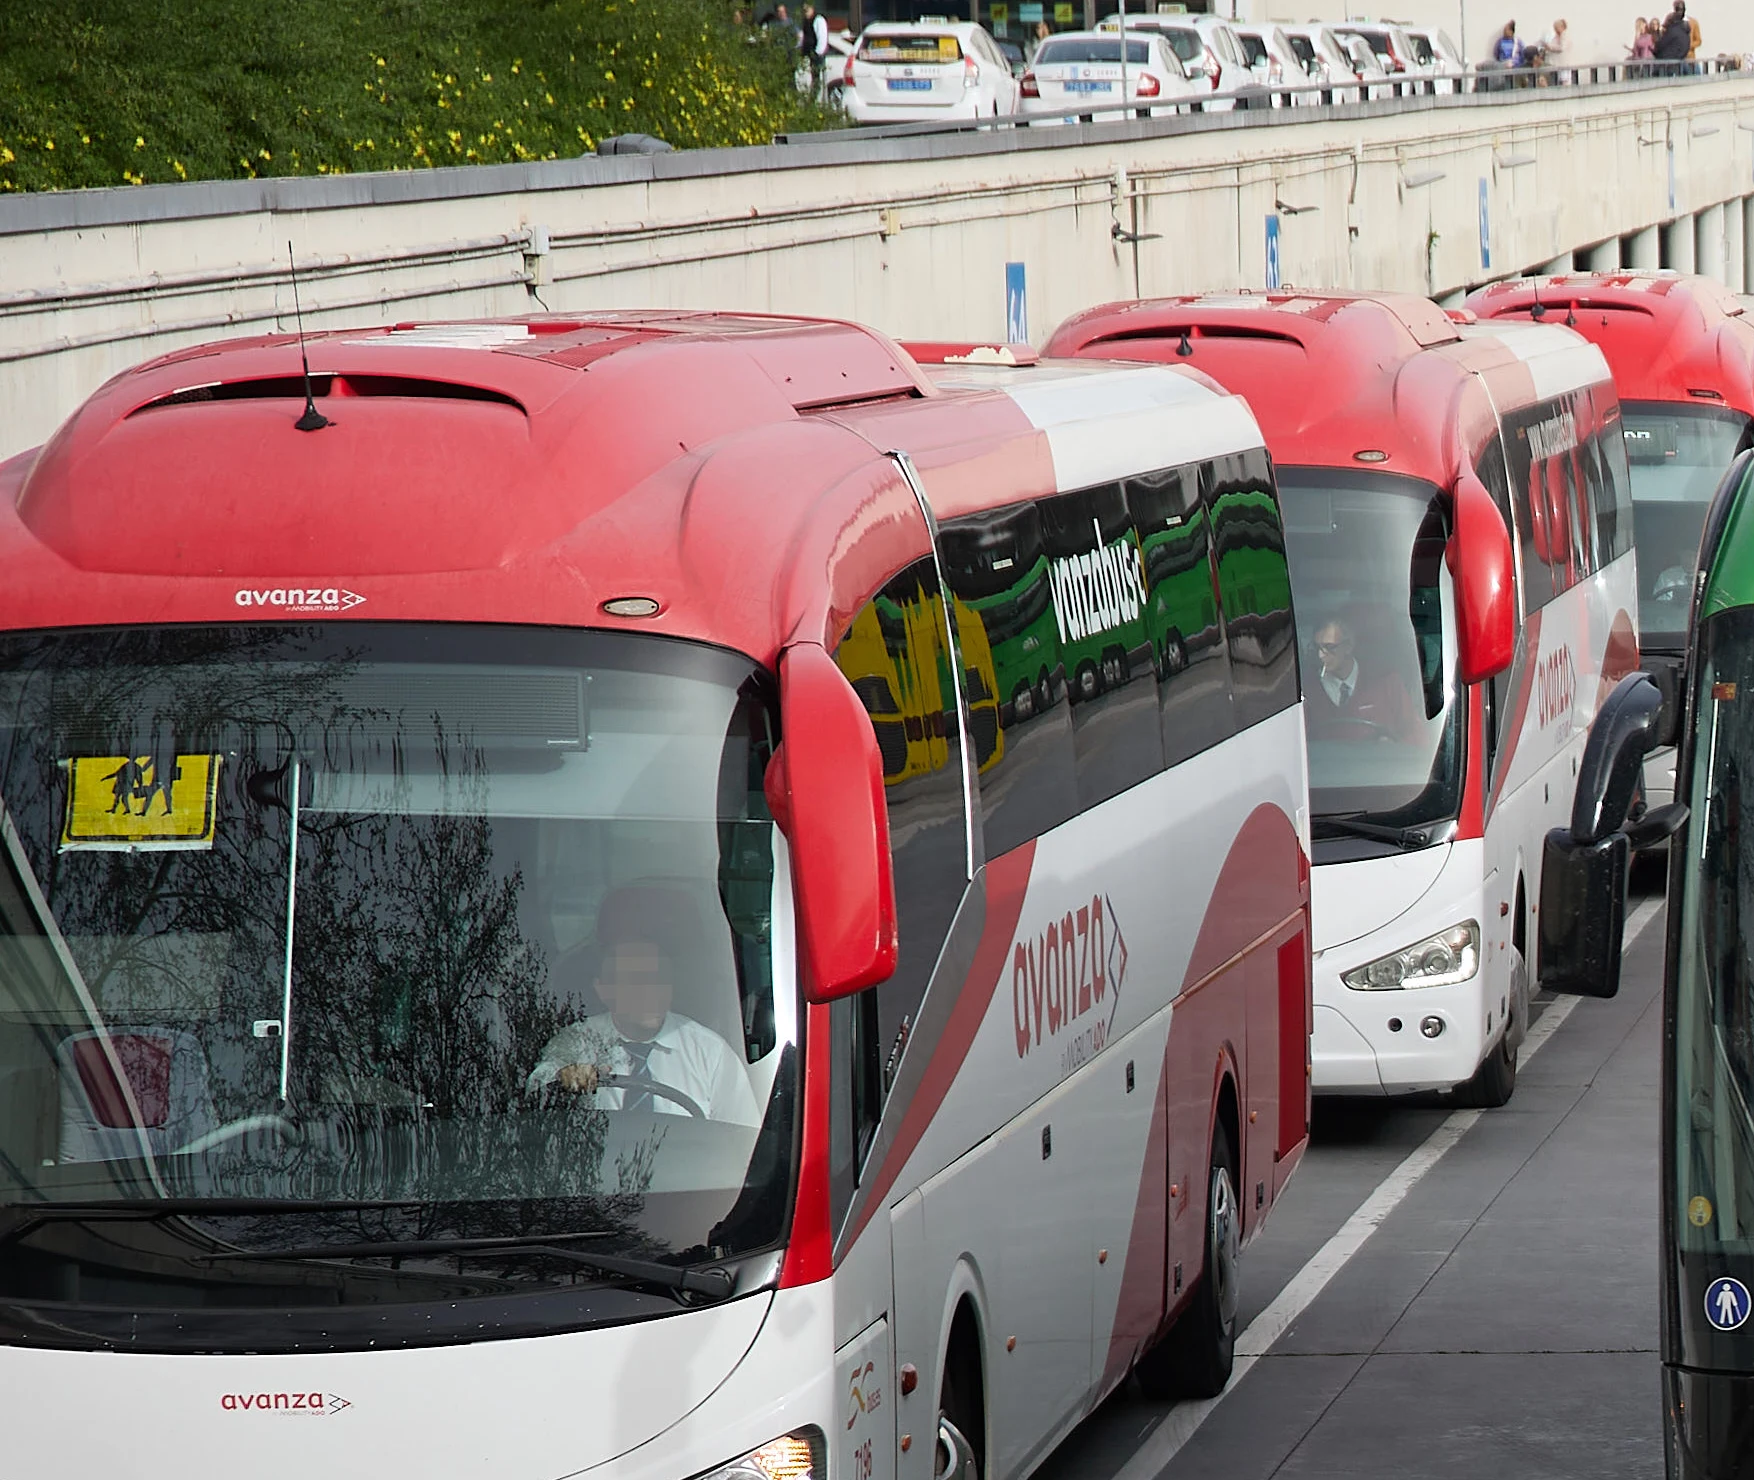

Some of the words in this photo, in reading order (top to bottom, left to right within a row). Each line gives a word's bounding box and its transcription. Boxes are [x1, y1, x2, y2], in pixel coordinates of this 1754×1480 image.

[234, 588, 339, 606] avanza
[1013, 893, 1107, 1059] avanza
[221, 1392, 324, 1410] avanza
